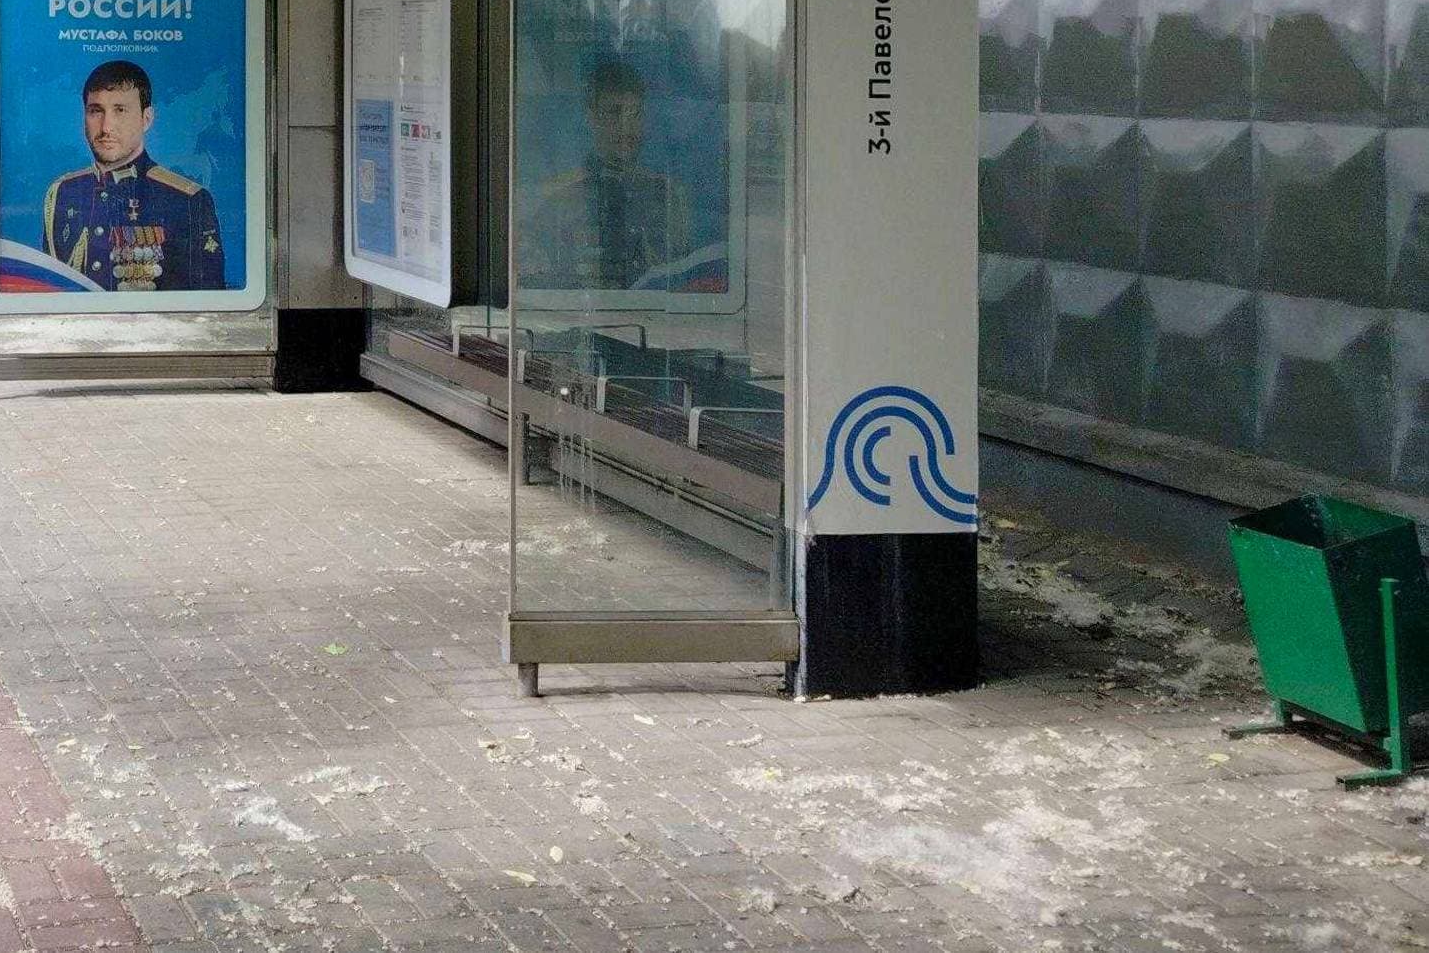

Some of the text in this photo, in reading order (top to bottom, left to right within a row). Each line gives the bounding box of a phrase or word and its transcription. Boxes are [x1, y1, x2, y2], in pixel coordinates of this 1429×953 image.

[58, 29, 184, 41] МУСТАФА БОКОВ
[82, 44, 159, 54] ПОДПОЛКОВНИК
[868, 109, 892, 155] 3-й
